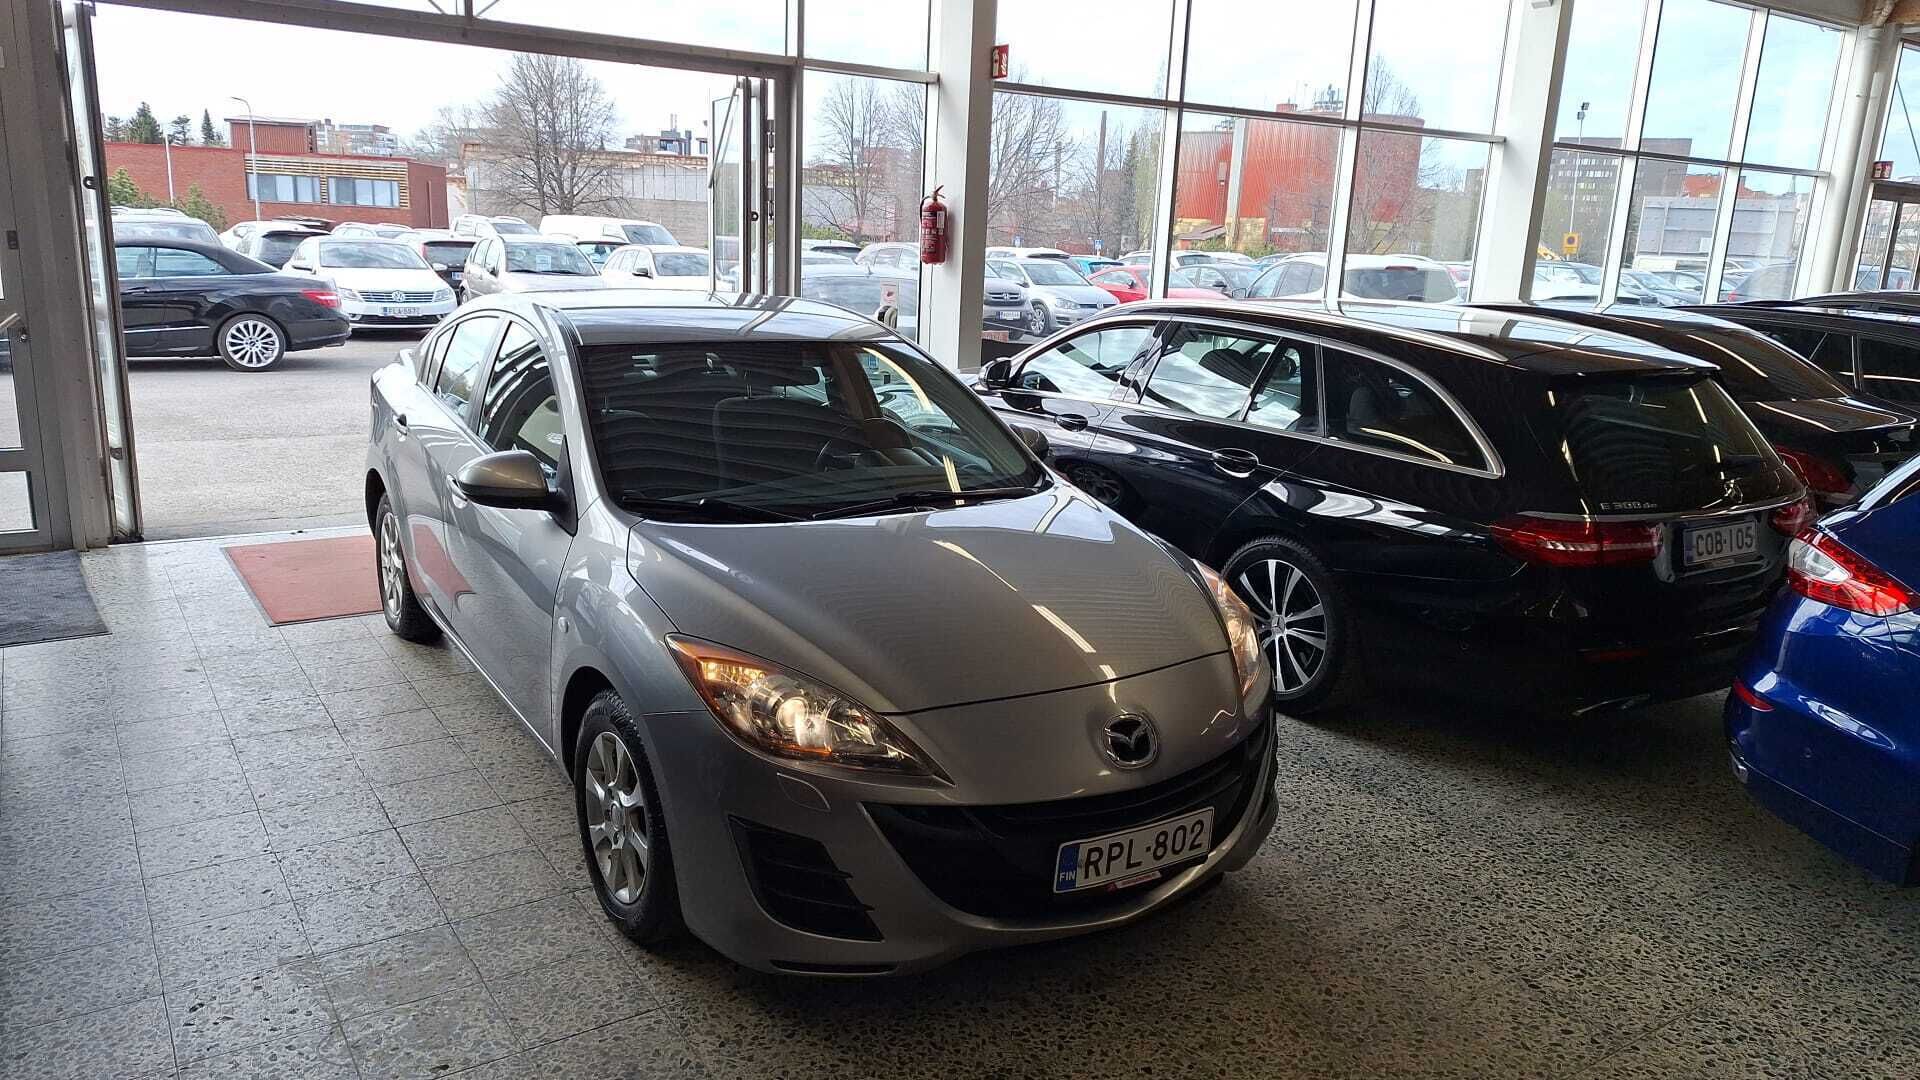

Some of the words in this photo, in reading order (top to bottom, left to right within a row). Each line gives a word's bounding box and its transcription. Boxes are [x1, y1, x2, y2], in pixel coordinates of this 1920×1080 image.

[1599, 502, 1611, 510] E
[1696, 526, 1754, 557] COB-105
[1084, 819, 1205, 879] RPL-802
[1059, 871, 1076, 882] FIN
